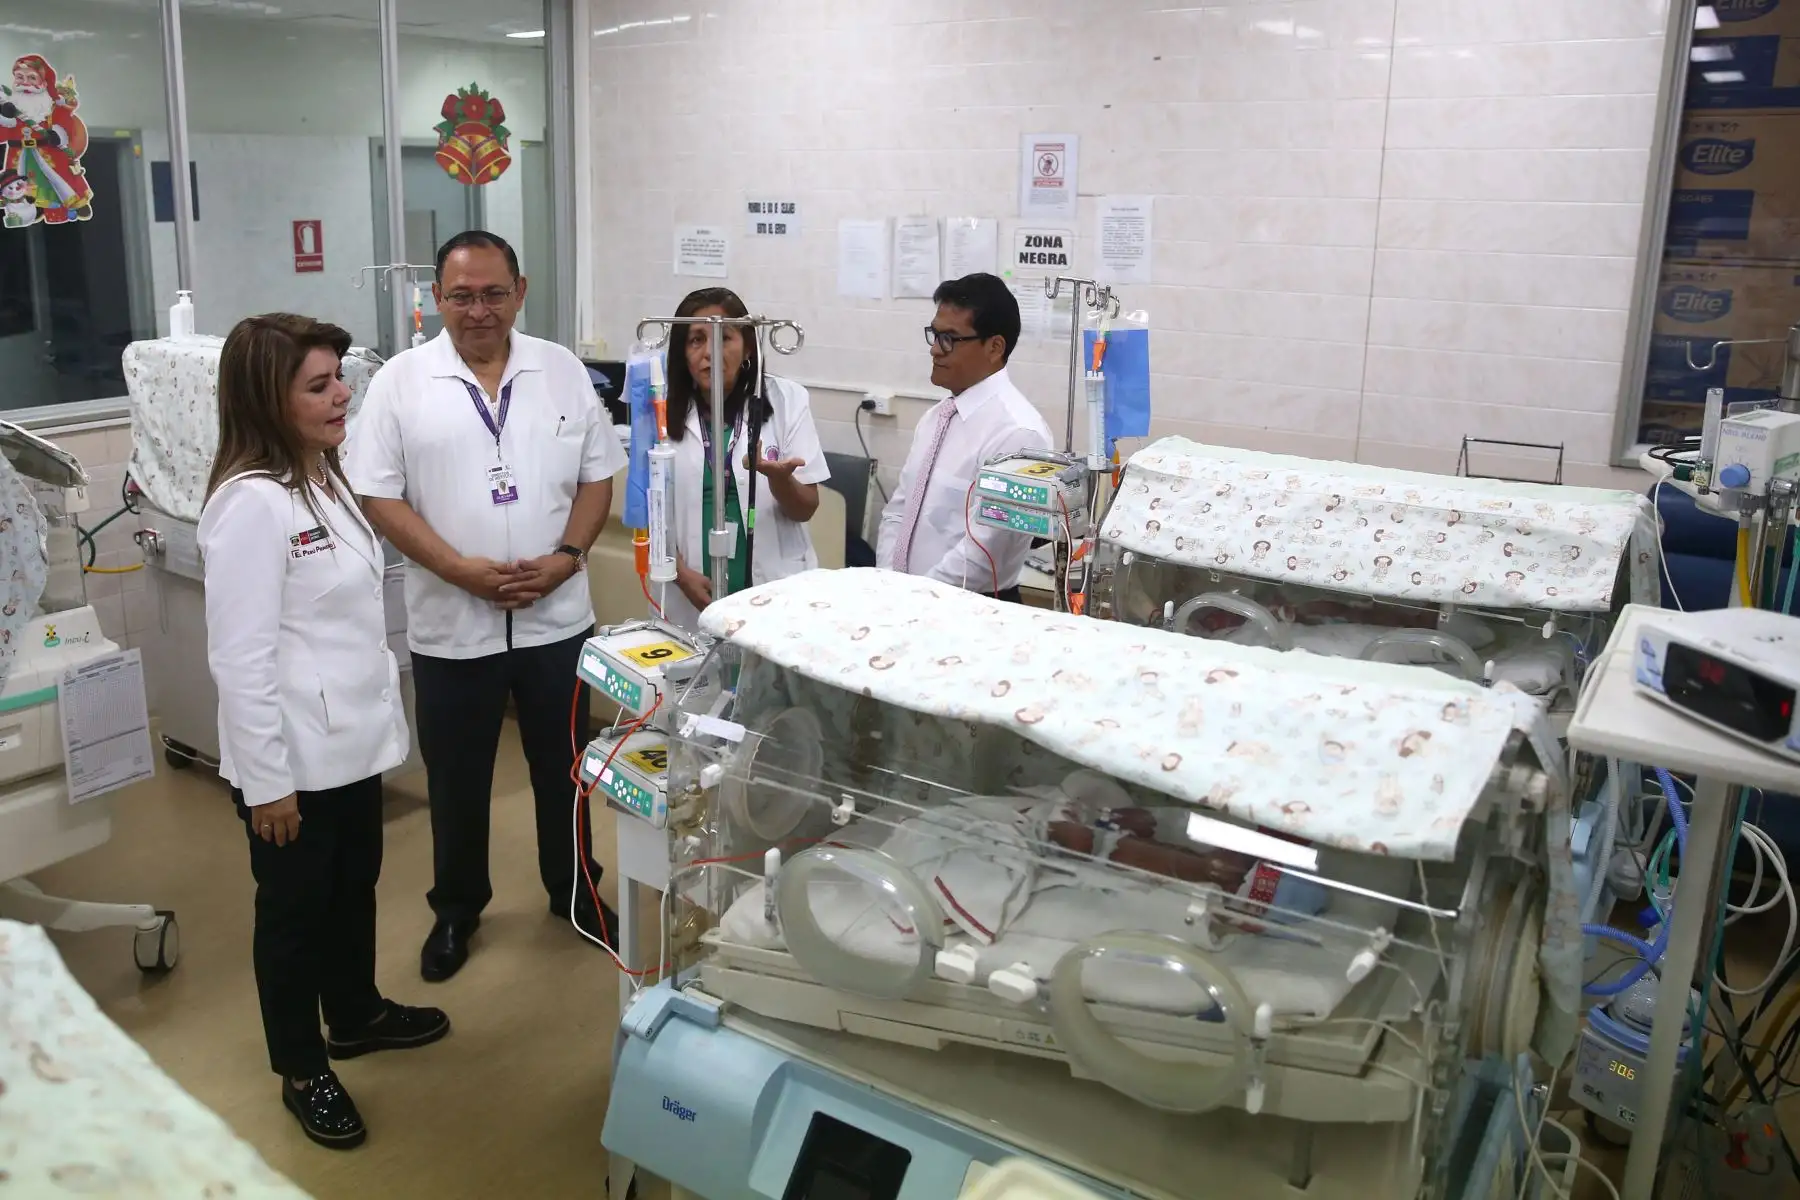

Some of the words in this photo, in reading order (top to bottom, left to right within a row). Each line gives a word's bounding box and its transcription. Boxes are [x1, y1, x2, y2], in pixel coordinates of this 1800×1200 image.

[1692, 144, 1745, 164] Elite
[1025, 236, 1063, 248] ZONA
[1019, 252, 1067, 265] NEGRA
[1673, 291, 1722, 311] Elite
[662, 1095, 697, 1123] Dräger
